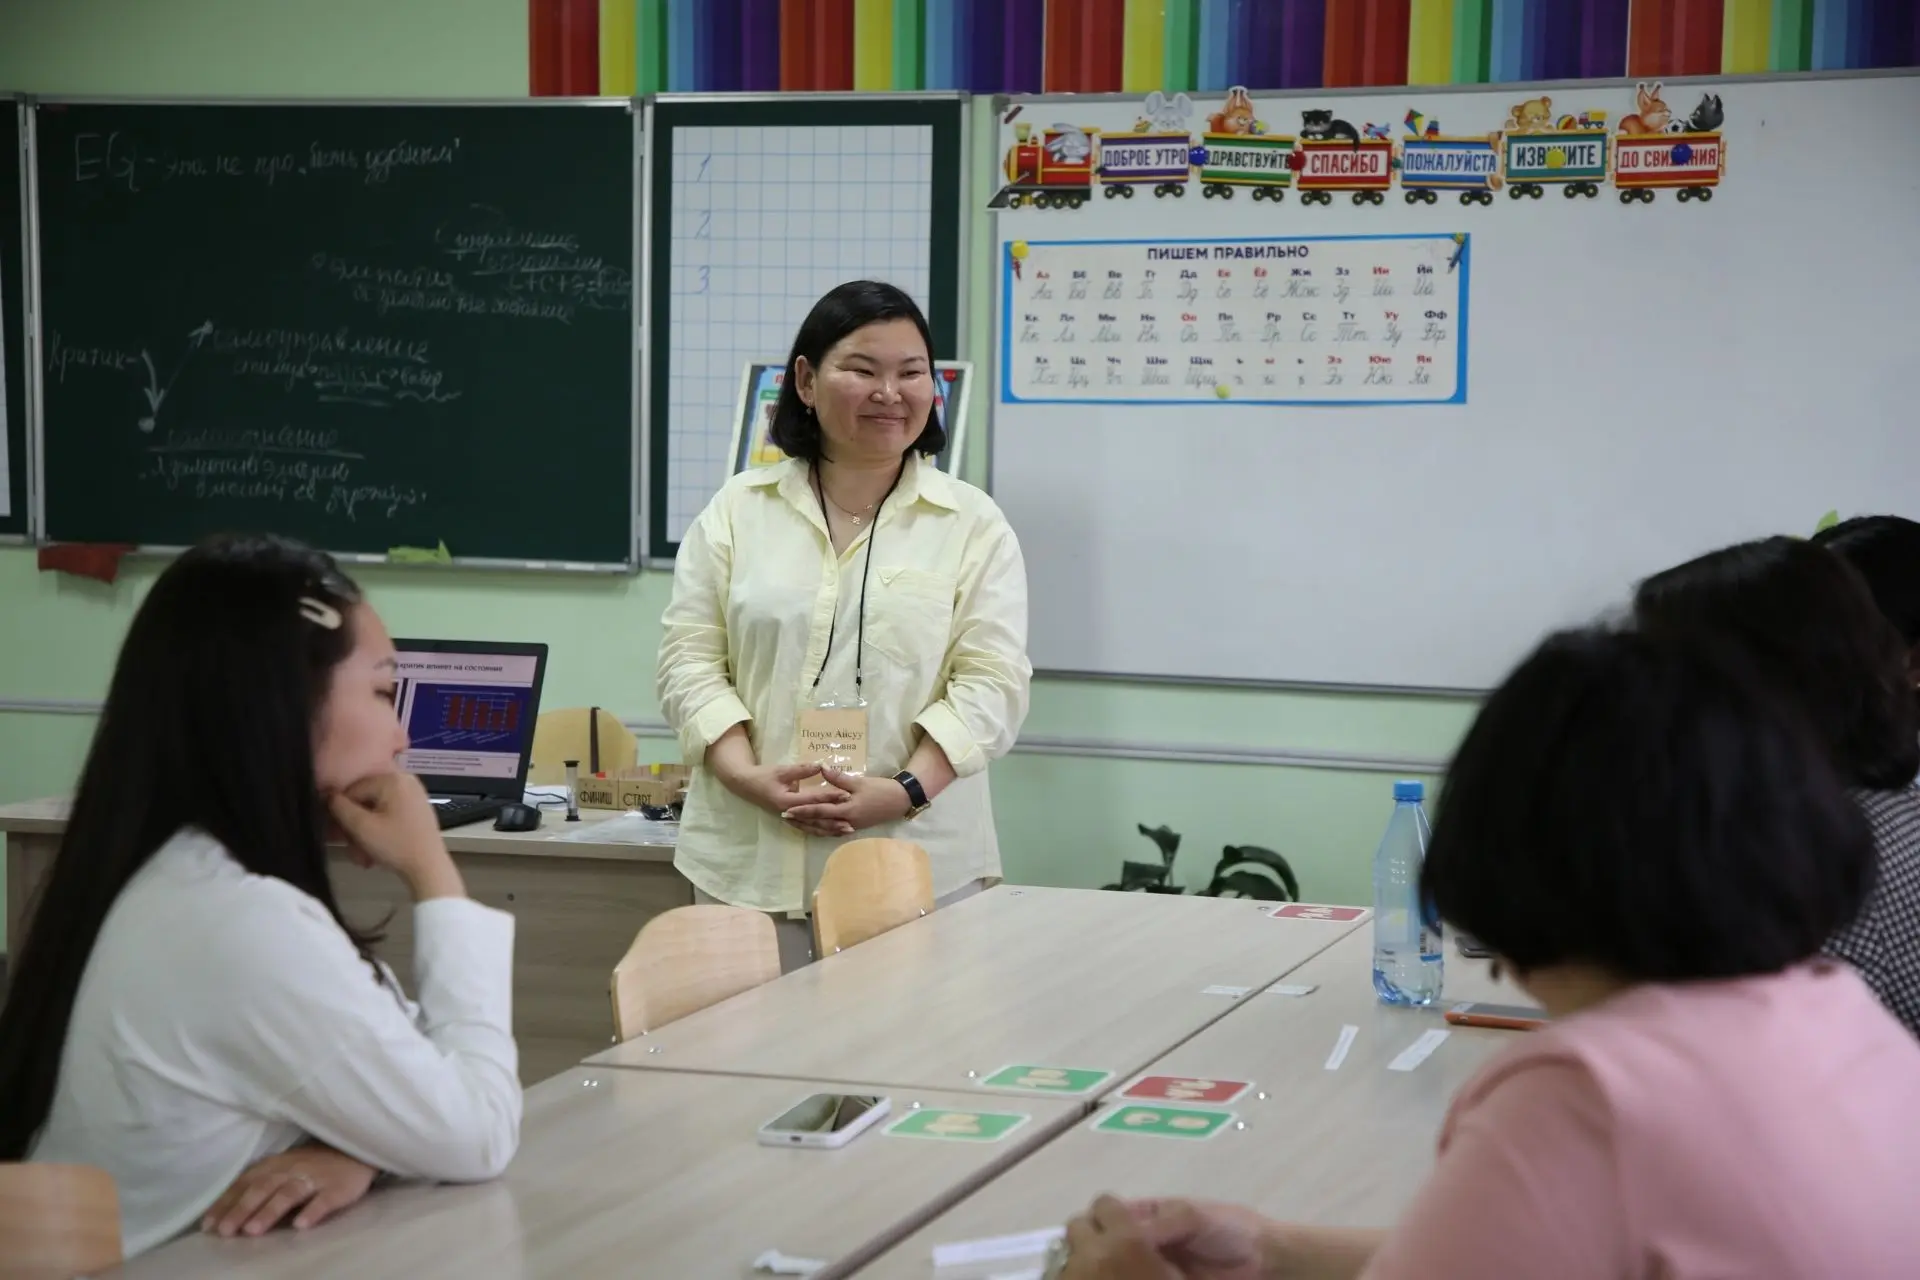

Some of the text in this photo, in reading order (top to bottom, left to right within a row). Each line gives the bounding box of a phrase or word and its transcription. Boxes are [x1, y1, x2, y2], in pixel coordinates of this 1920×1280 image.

[1104, 148, 1187, 167] ДОБРОЕ УТРО
[1312, 153, 1378, 173] СПАСИБО
[1406, 151, 1496, 172] ПОЖАЛУЙСТА
[1516, 145, 1596, 167] ИЗВИТЕ
[1620, 148, 1716, 168] ДО СВИНИЯ
[697, 153, 711, 182] 1
[694, 209, 711, 240] 2
[1147, 245, 1309, 260] ПИШЕМ ПРАВИЛЬНО
[697, 265, 711, 294] 3
[580, 790, 613, 805] ФИНИШ
